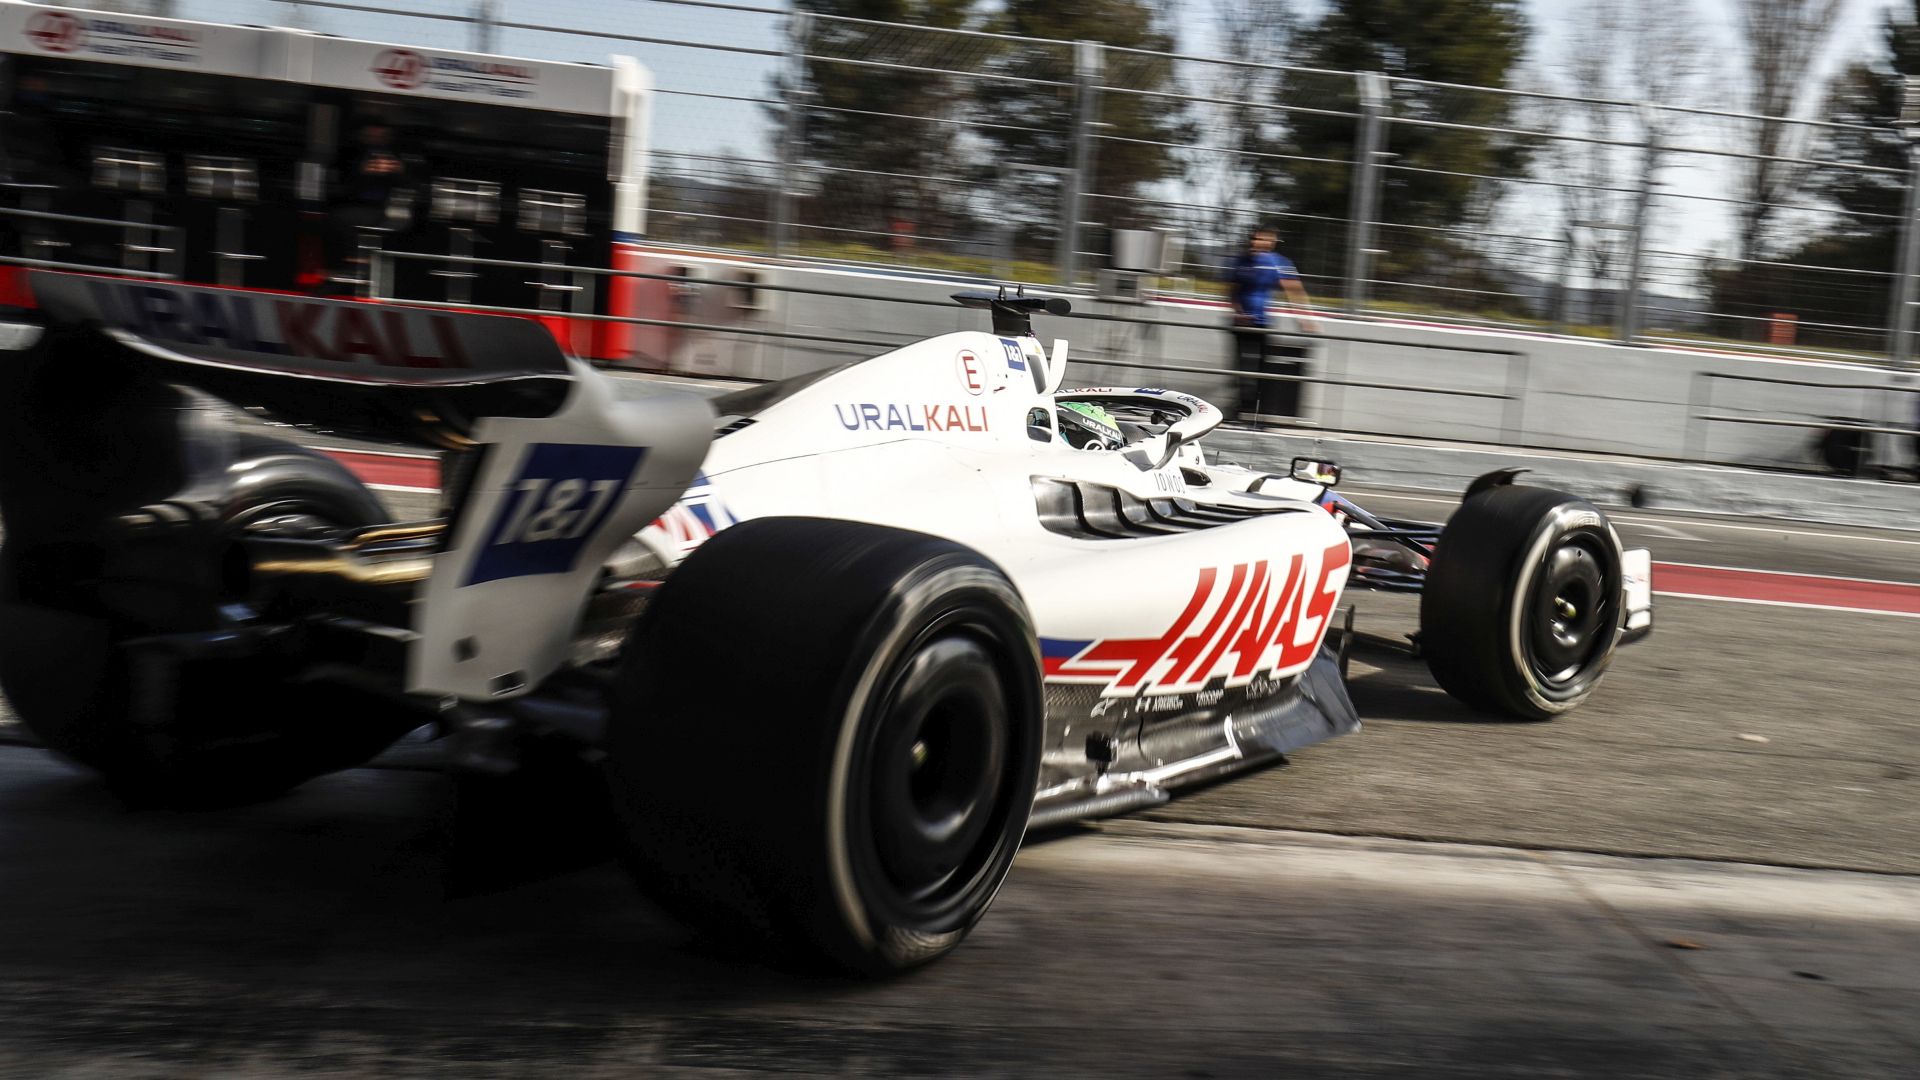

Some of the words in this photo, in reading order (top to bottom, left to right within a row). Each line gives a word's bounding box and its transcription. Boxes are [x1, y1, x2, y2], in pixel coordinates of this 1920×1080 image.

[1003, 343, 1023, 362] 1&1
[962, 356, 981, 389] E
[835, 403, 989, 432] URALKALI
[493, 477, 622, 545] 1&1
[1082, 540, 1350, 687] HAAS
